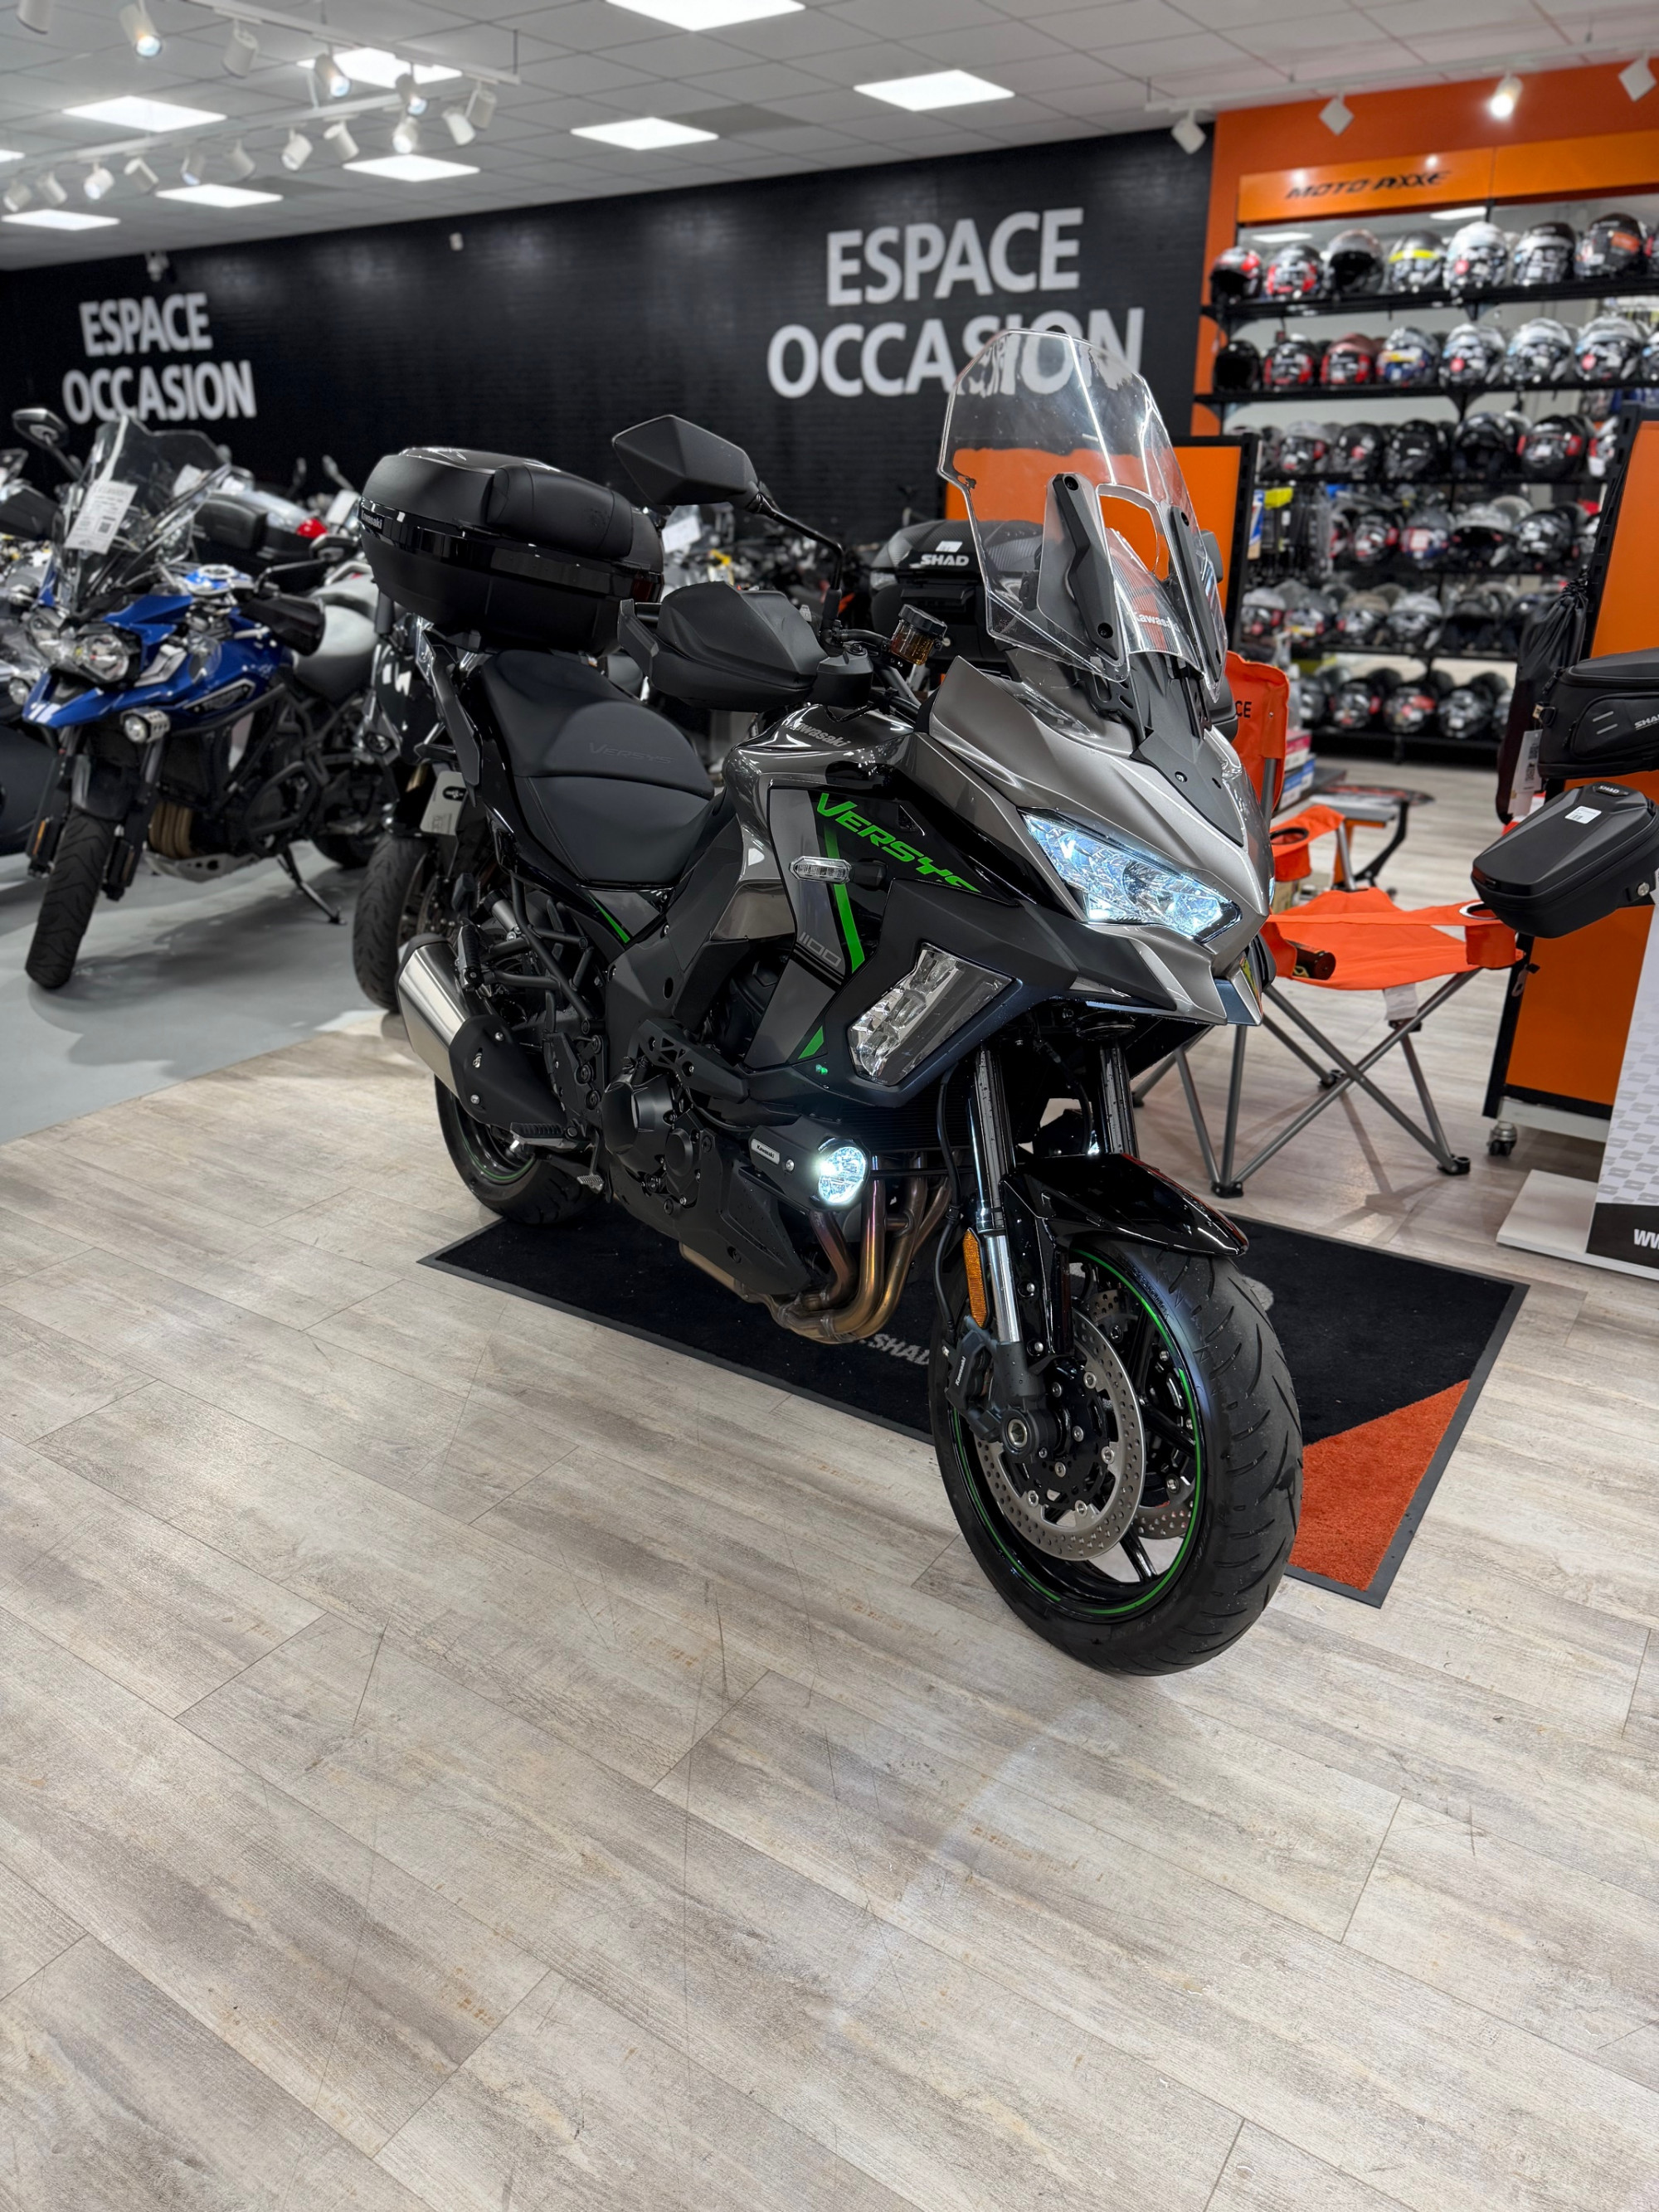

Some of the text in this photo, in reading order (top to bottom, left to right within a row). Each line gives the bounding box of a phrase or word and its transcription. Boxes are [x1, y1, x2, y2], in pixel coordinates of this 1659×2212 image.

[1286, 177, 1369, 200] MOTO
[826, 207, 1084, 306] ESPACE
[79, 293, 213, 357] ESPACE
[767, 308, 1145, 399] OCCASION
[62, 360, 257, 424] OCCASION
[920, 553, 970, 566] SHAD
[589, 742, 675, 764] VERSYS
[1598, 785, 1620, 794] SHAD
[799, 931, 842, 968] 1100
